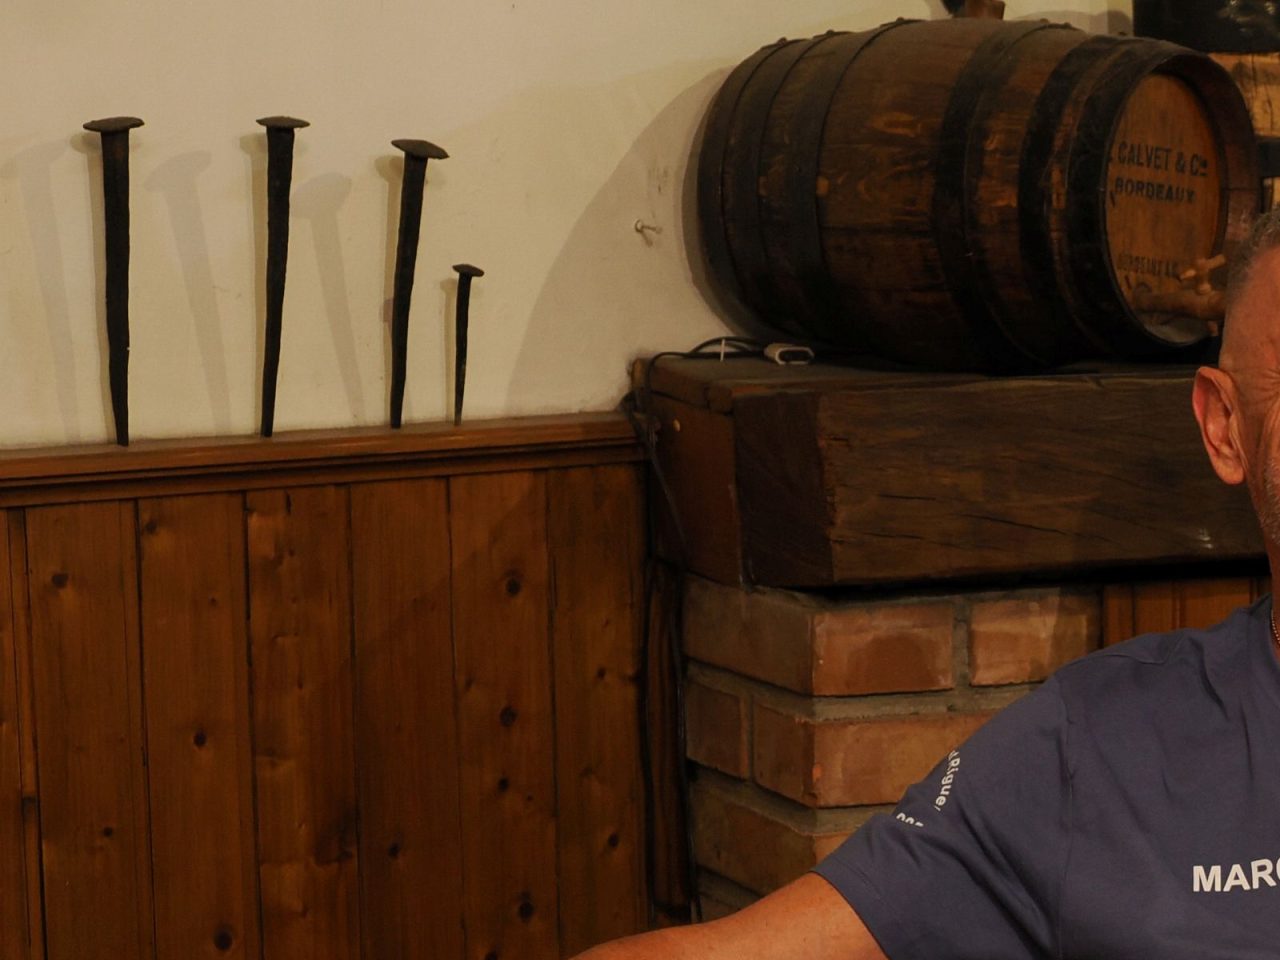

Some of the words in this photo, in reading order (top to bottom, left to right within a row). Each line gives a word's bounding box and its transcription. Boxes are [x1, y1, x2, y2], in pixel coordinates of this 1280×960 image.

[1118, 141, 1172, 171] CALVET
[1175, 152, 1186, 174] &
[1115, 177, 1195, 204] BORDEAUX
